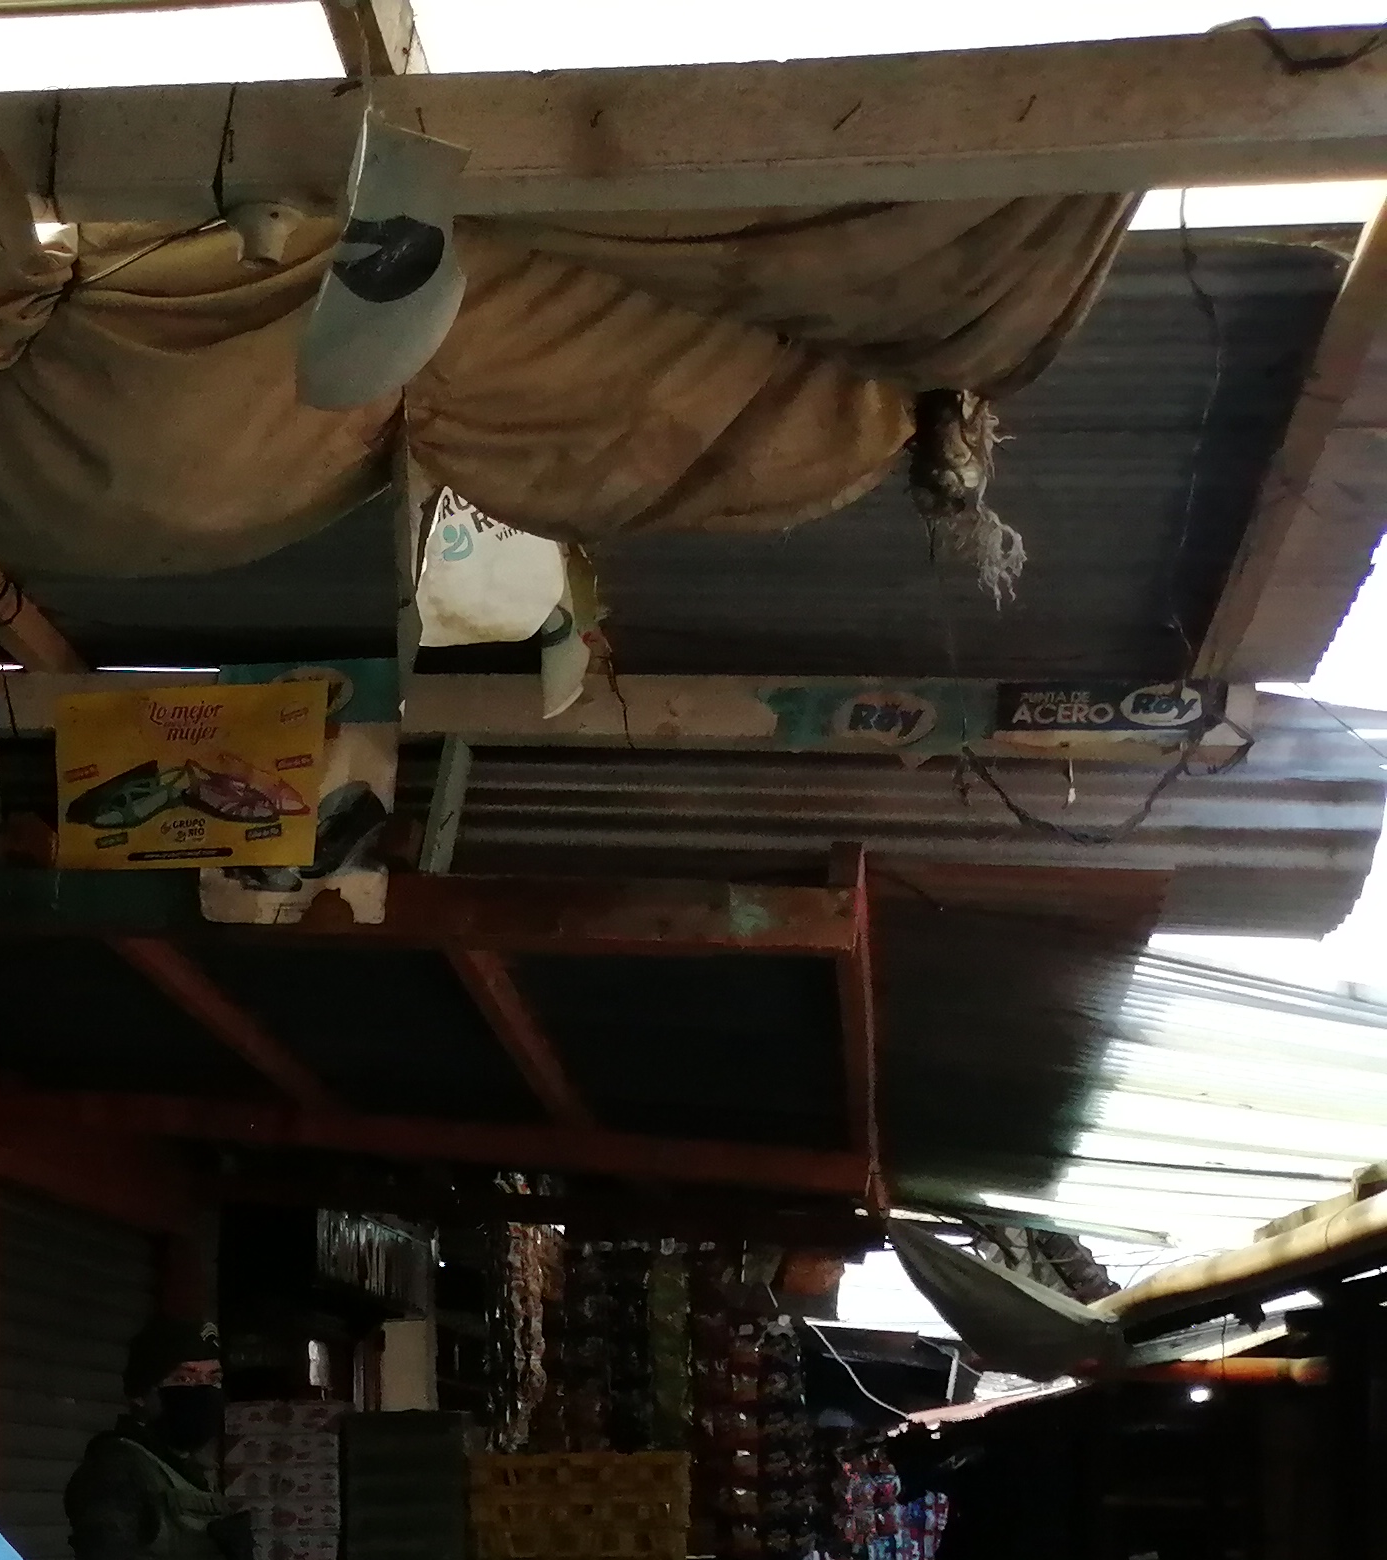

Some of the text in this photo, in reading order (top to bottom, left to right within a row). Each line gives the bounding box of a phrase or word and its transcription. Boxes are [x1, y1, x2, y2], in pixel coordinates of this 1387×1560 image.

[149, 700, 225, 725] Lo mejor
[1011, 703, 1115, 725] ACERO
[166, 722, 219, 746] mujer
